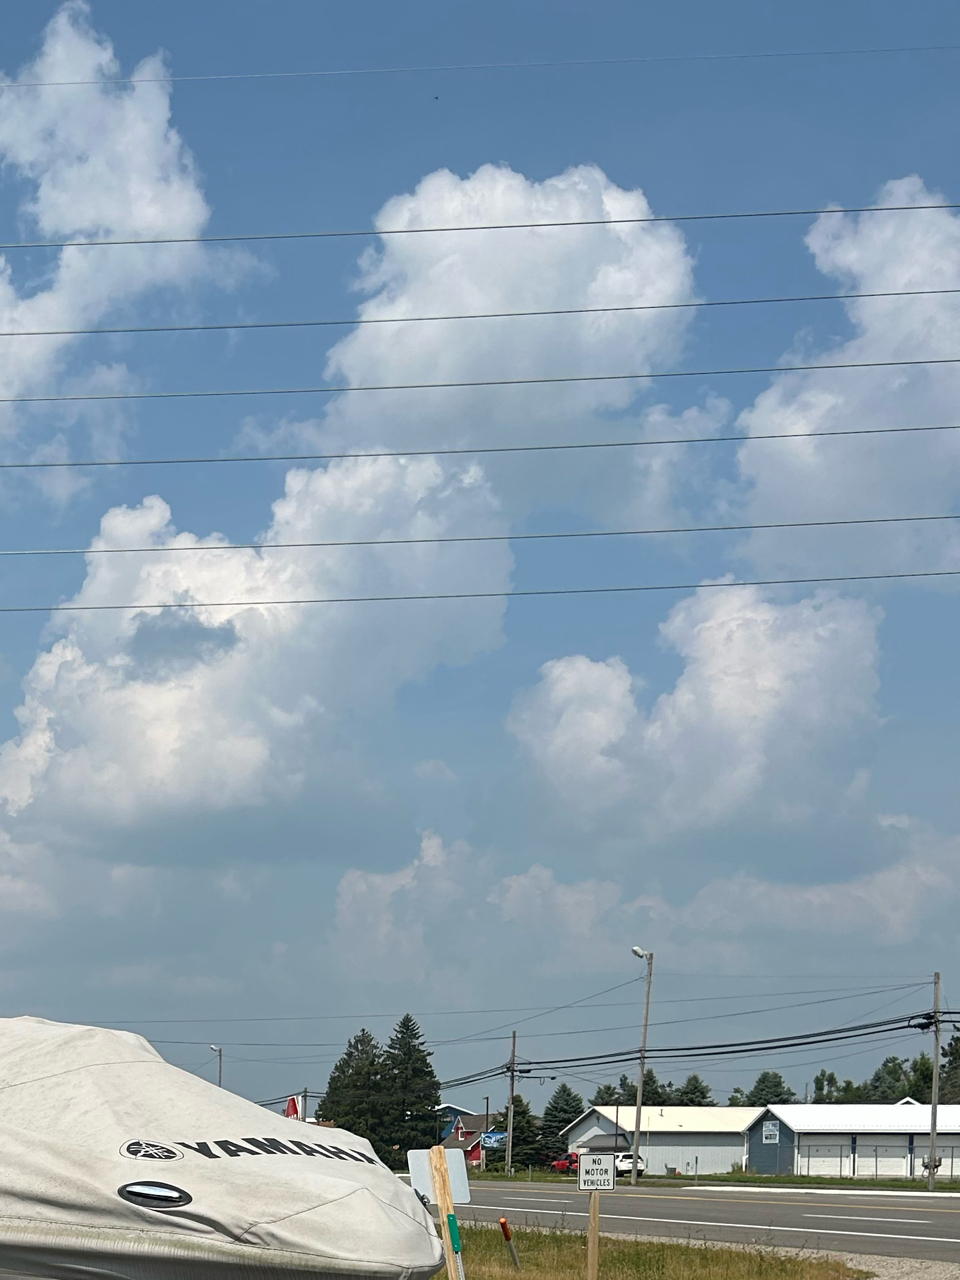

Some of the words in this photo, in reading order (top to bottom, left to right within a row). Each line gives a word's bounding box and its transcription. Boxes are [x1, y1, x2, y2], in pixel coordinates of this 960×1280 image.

[592, 1157, 602, 1166] NO
[584, 1168, 609, 1176] MOTOR
[582, 1178, 611, 1187] VEHICLES
